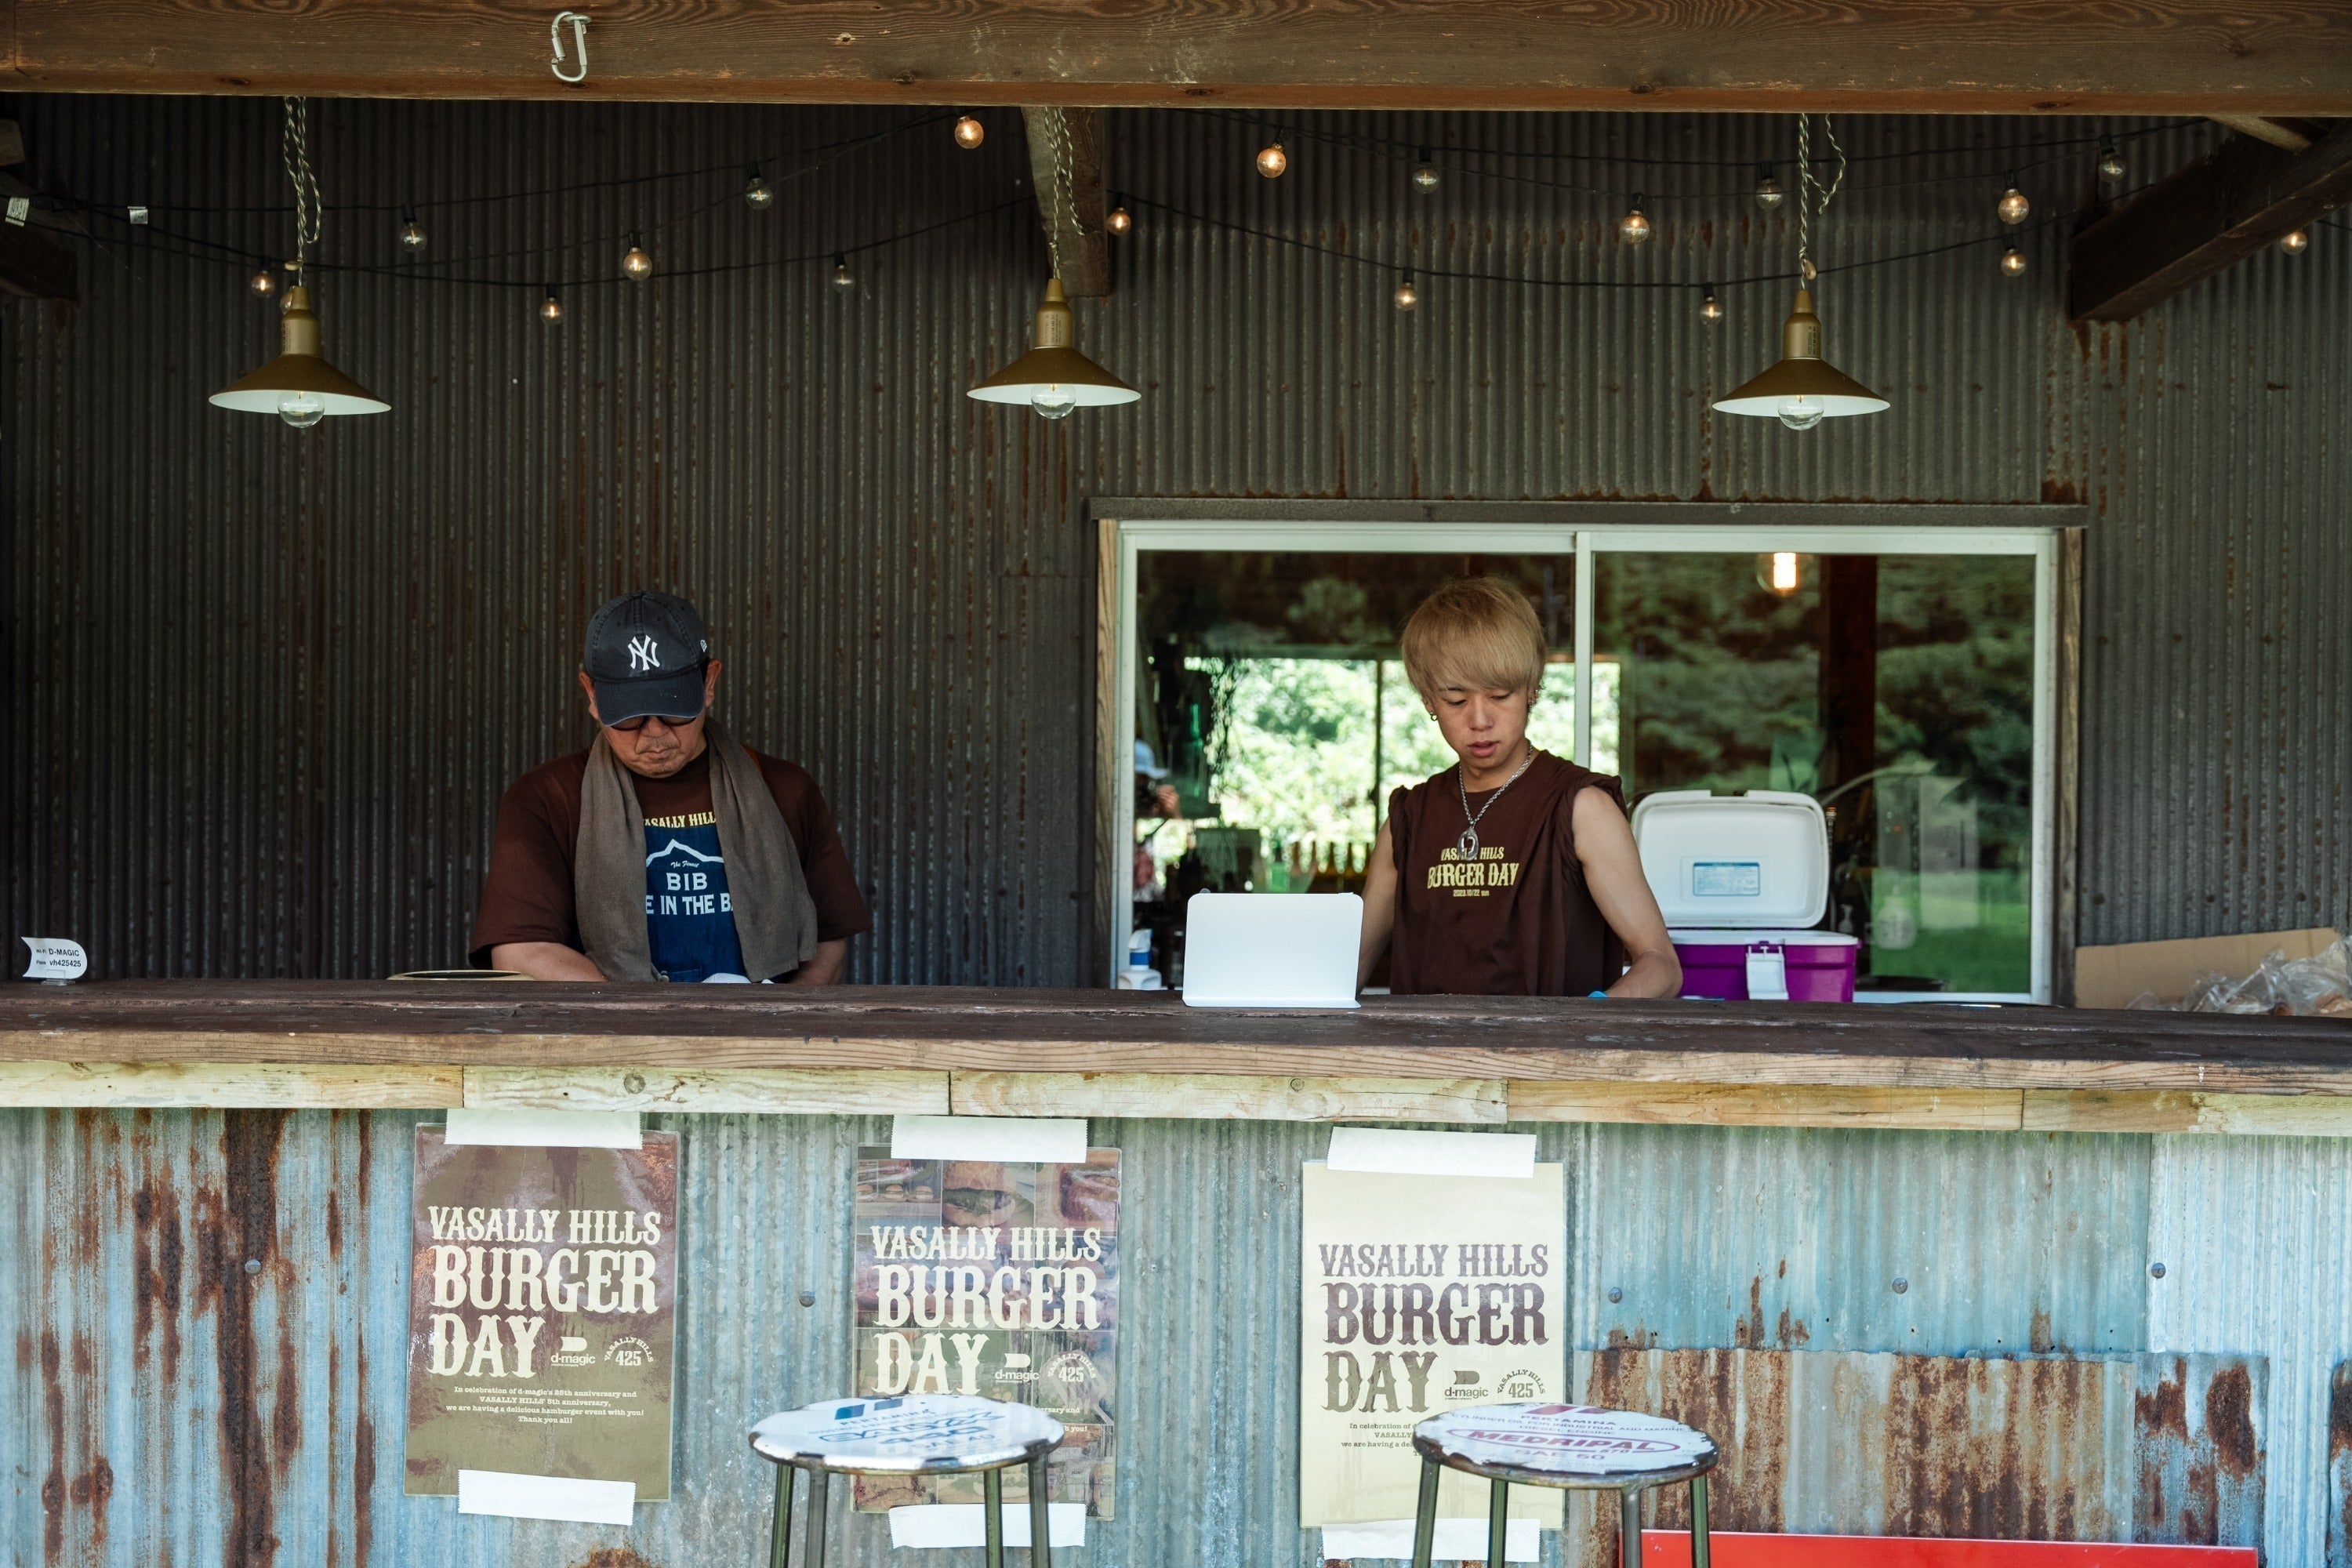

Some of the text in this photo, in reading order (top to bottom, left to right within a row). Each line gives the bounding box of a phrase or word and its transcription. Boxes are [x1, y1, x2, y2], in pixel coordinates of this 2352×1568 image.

[627, 634, 661, 671] NY
[643, 811, 717, 828] ASALLY HILL
[1479, 847, 1504, 860] HILLS
[666, 872, 708, 891] BIB
[1427, 862, 1520, 889] BURGER DAY
[660, 895, 677, 916] IN
[682, 894, 715, 916] THE
[720, 892, 733, 913] B
[49, 948, 79, 956] D-MAGIC
[427, 1206, 661, 1245] VASALLY HILLS
[869, 1225, 1102, 1261] VASALLY HILLS
[1318, 1244, 1548, 1277] VASALLY HILLS
[428, 1245, 660, 1314] BURGER
[872, 1264, 1102, 1330] BURGER
[1320, 1282, 1549, 1346] BURGER
[426, 1313, 546, 1378] DAY
[604, 1337, 654, 1363] VASALLY HILLS
[550, 1352, 596, 1366] d-magic
[615, 1350, 642, 1367] 425
[871, 1332, 990, 1395] DAY
[1047, 1353, 1096, 1379] VASALLY HILLS
[995, 1370, 1040, 1382] d-magic
[1058, 1367, 1084, 1382] 425
[1321, 1350, 1439, 1413] DAY
[1497, 1369, 1545, 1394] VASALLY HILLS
[1444, 1387, 1489, 1399] d-magic
[1508, 1383, 1534, 1398] 425
[542, 1407, 583, 1416] hamburger
[1521, 1415, 1616, 1425] PERTAMINA
[1468, 1429, 1655, 1450] MEDRIPAL
